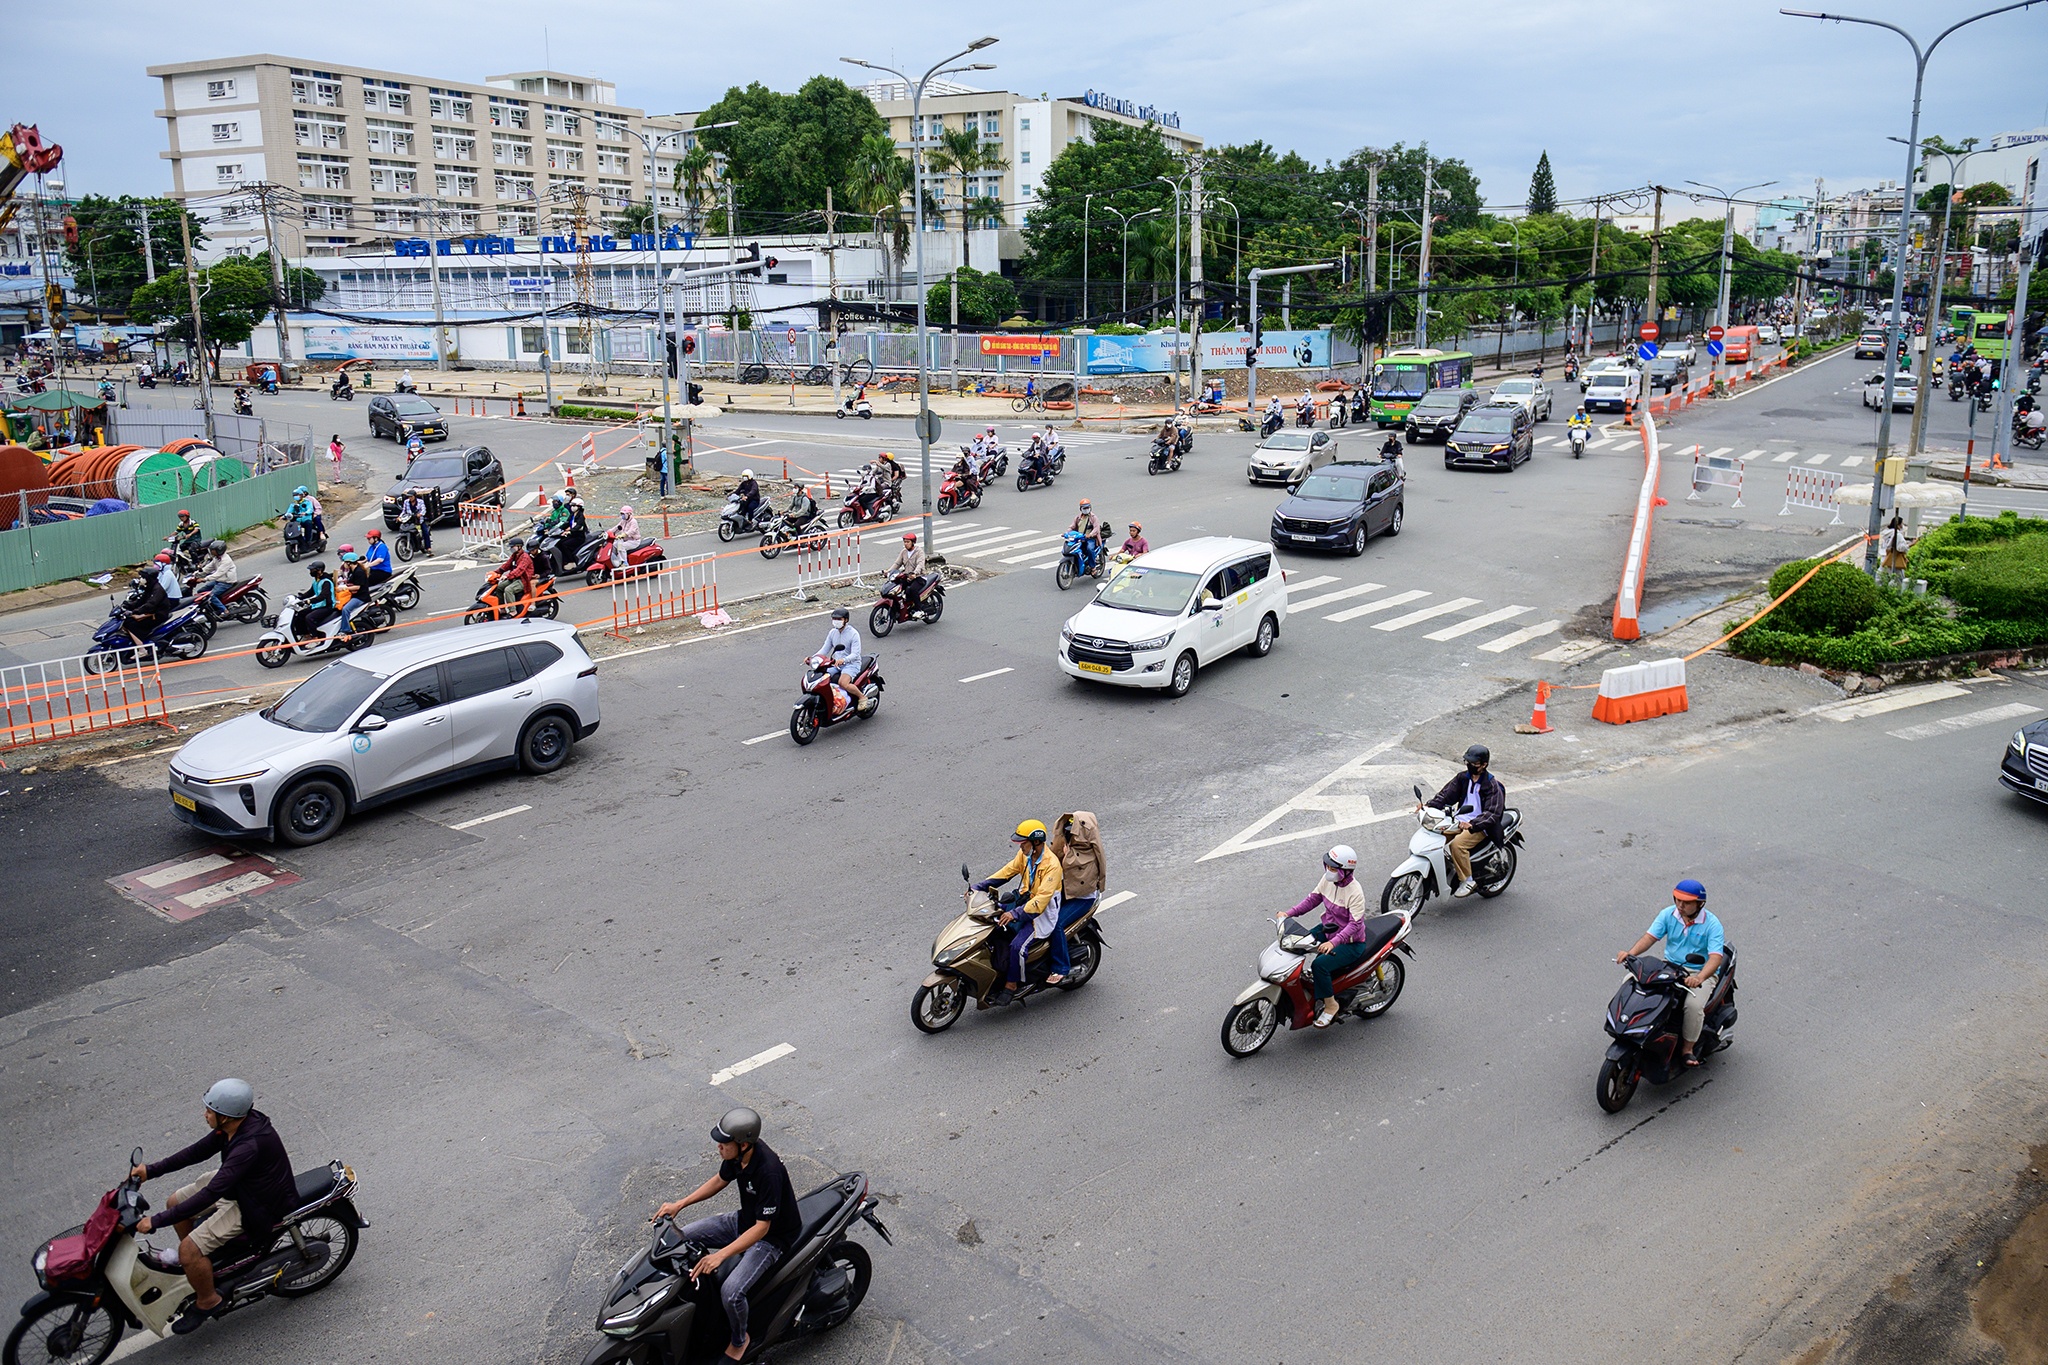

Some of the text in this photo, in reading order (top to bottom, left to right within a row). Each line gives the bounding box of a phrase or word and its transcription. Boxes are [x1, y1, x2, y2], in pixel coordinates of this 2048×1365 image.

[2007, 135, 2033, 143] THANH
[462, 234, 515, 258] VIỆN
[1210, 343, 1233, 356] THẨM
[1265, 345, 1288, 354] KHOA
